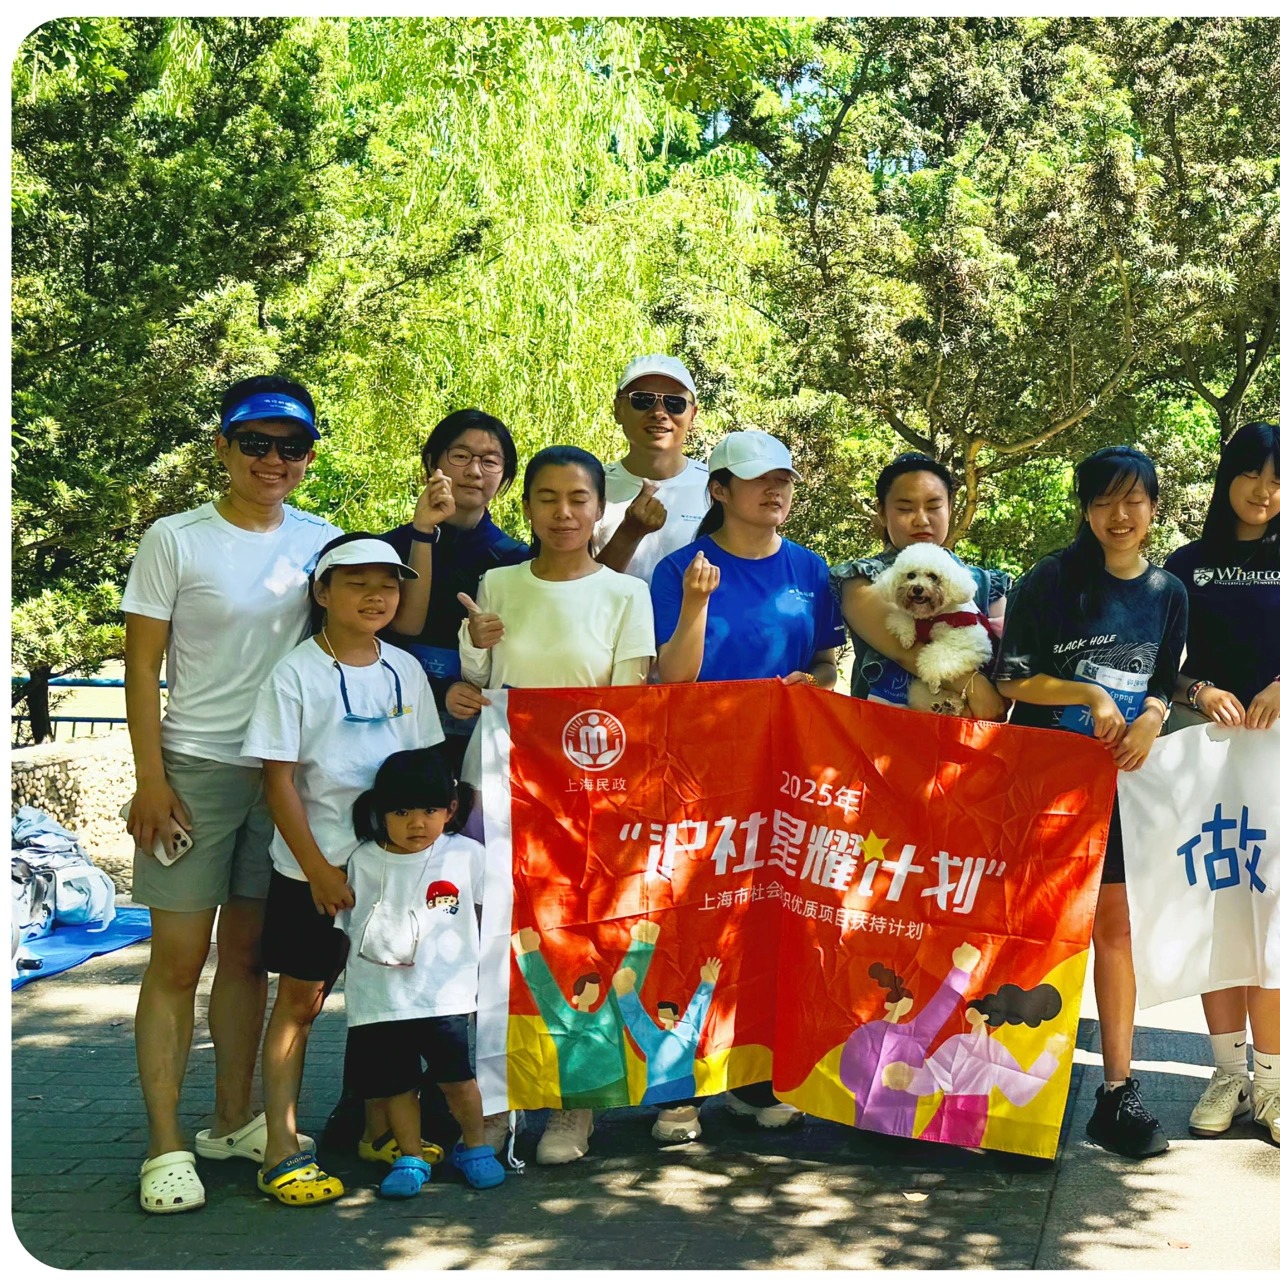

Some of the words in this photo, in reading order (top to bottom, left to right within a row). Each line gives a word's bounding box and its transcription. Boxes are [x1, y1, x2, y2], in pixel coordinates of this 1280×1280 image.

[1089, 634, 1117, 646] HOLE
[565, 777, 626, 792] 上海民政
[780, 770, 863, 815] 2025年
